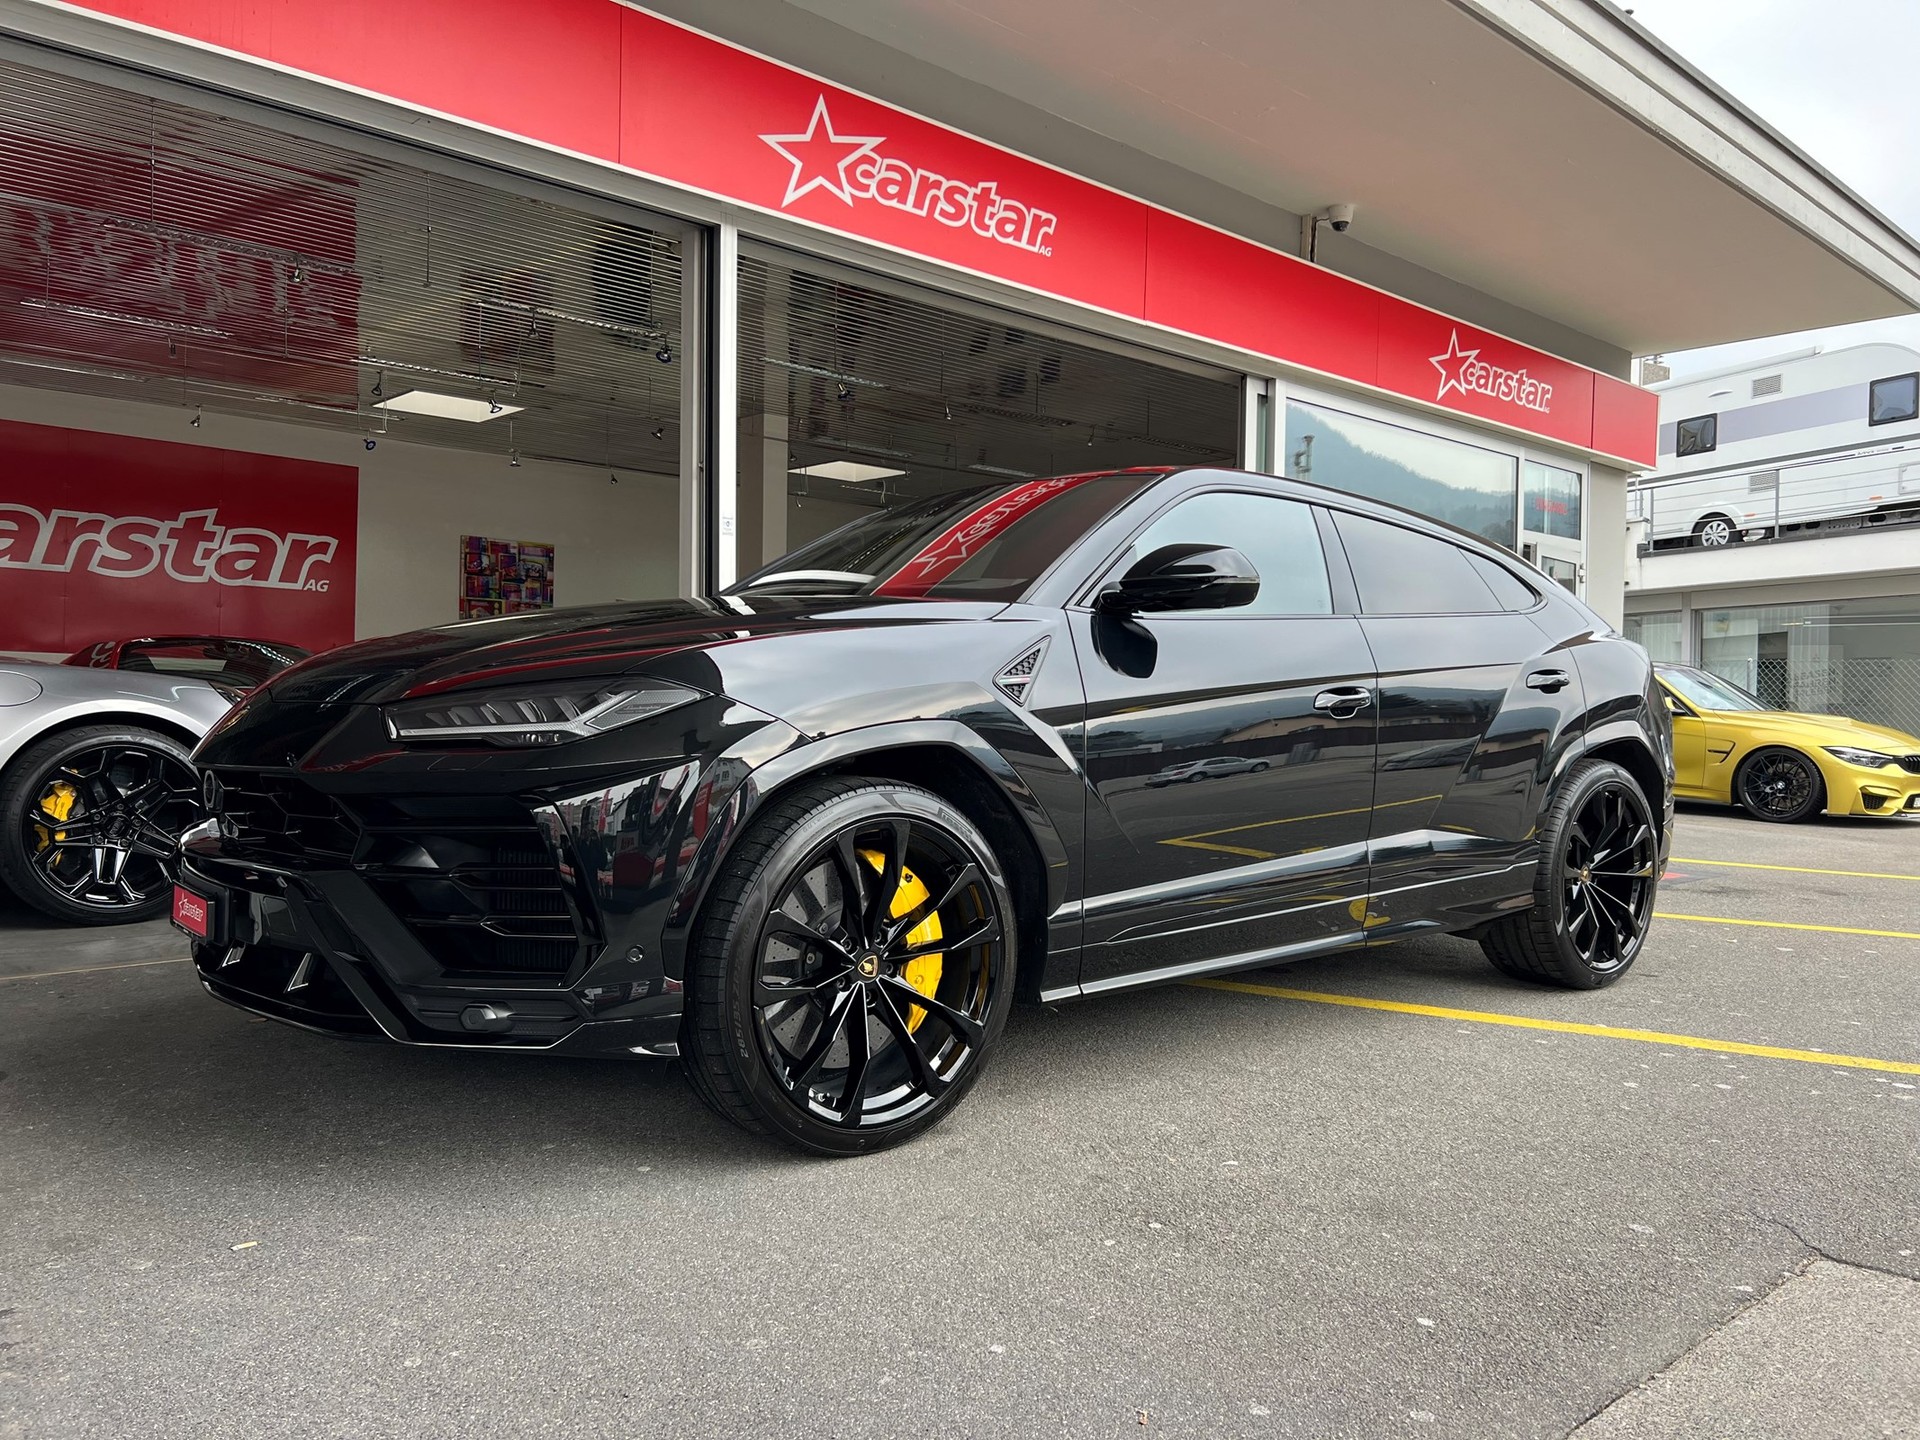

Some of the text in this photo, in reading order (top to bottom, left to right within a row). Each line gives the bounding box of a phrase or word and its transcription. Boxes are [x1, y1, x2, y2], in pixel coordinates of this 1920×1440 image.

[841, 149, 1057, 257] carstar AG
[1461, 359, 1552, 412] carstar
[304, 579, 331, 592] AG
